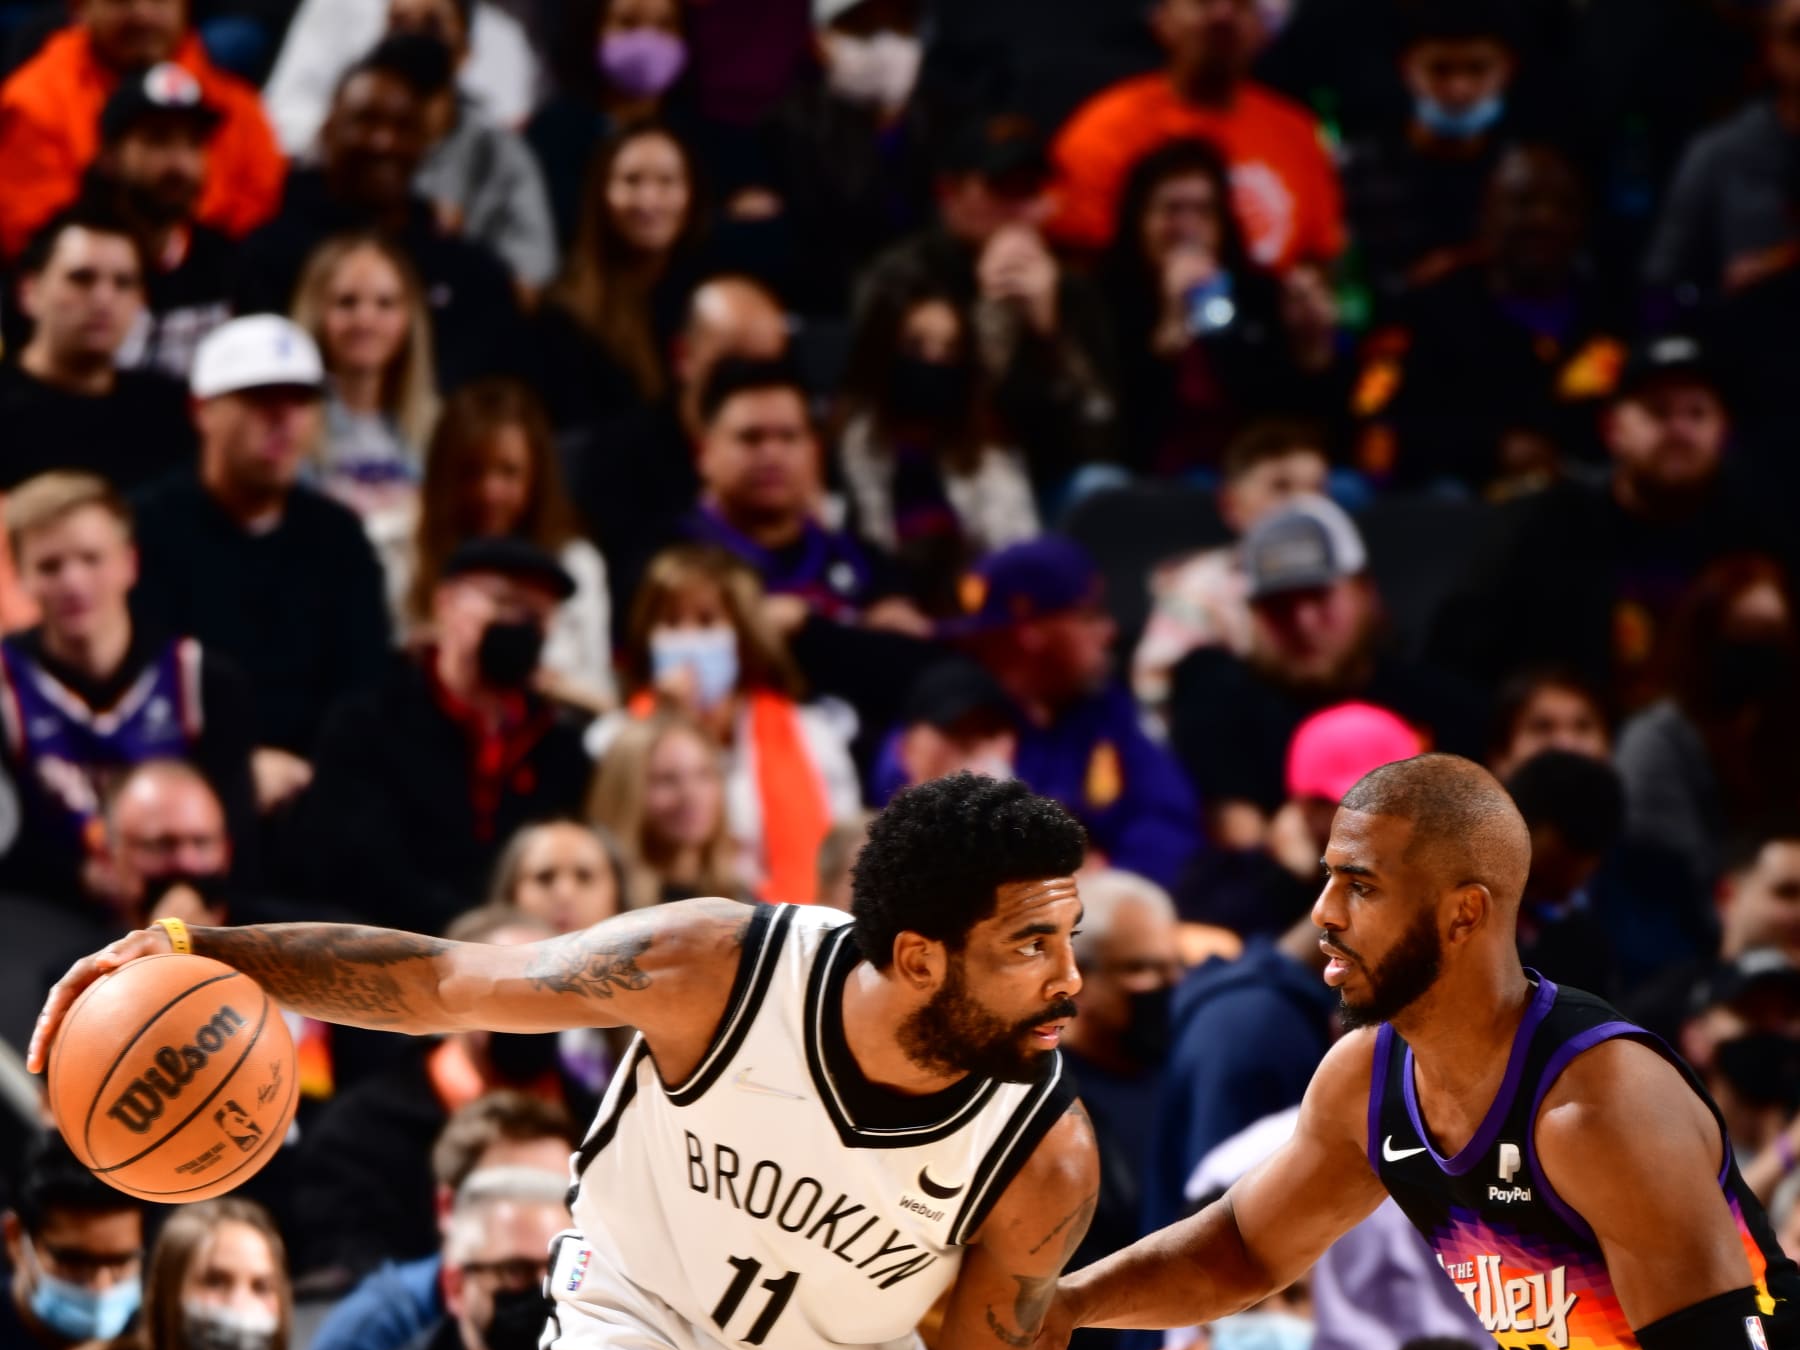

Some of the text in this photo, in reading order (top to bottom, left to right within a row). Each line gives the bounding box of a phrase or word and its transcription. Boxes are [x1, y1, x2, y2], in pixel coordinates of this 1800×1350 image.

[106, 1005, 248, 1134] Wilson
[684, 1129, 939, 1290] BROOKLYN
[1488, 1186, 1532, 1204] PayPal
[711, 1254, 801, 1346] 11
[1436, 1253, 1578, 1350] lley
[1447, 1261, 1475, 1280] THE
